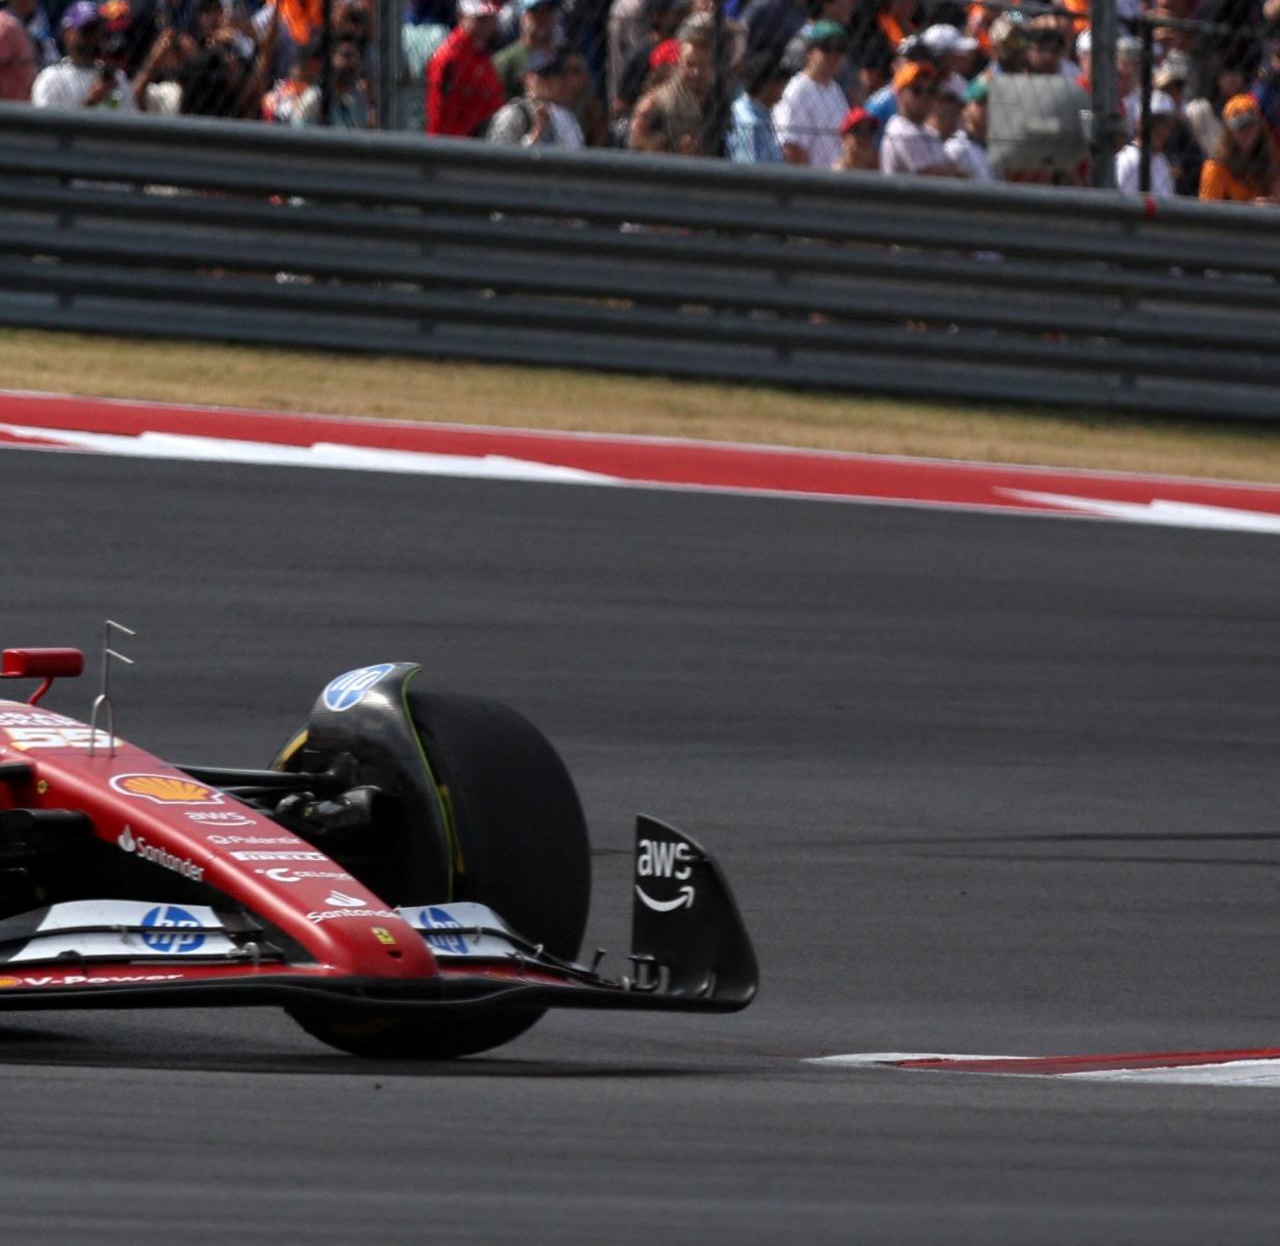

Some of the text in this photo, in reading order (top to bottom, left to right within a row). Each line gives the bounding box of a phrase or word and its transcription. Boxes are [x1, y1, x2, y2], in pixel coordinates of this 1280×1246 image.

[323, 663, 396, 712] hp
[3, 727, 125, 752] 55
[184, 811, 247, 821] aws
[136, 837, 205, 883] Santander
[229, 851, 329, 862] PIRELLI
[637, 838, 694, 880] aws
[140, 905, 207, 953] hp
[418, 907, 469, 955] hp
[24, 972, 184, 987] V-Power
